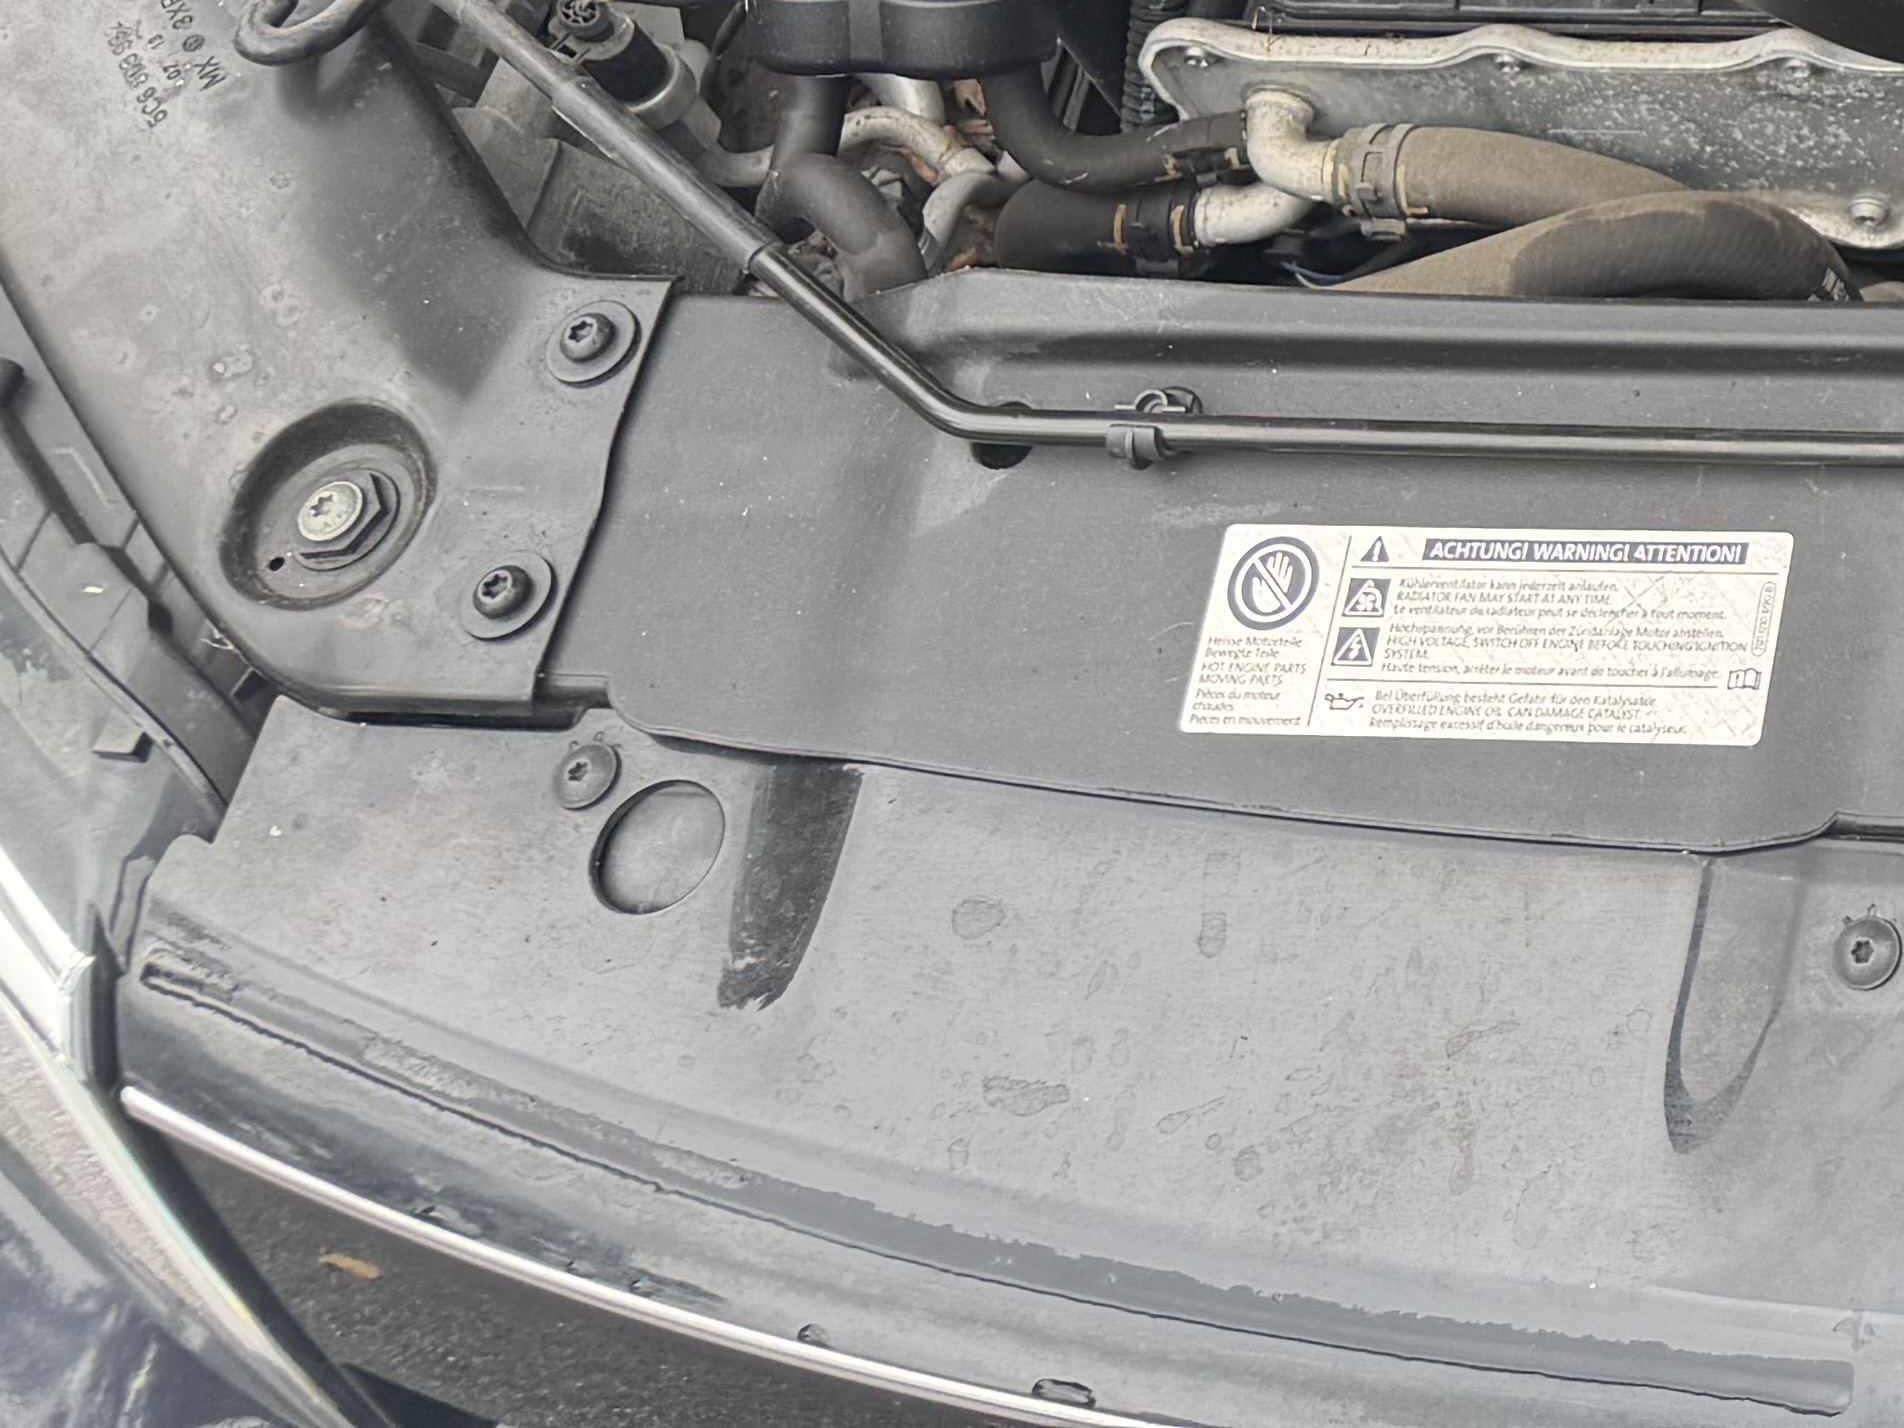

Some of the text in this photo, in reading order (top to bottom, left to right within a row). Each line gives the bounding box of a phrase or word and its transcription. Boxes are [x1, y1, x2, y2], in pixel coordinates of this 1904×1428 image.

[192, 55, 227, 92] MX
[1429, 541, 1742, 563] ACHTUNG! WARNING! ATTENTION!
[1455, 592, 1476, 602] FAN
[1506, 592, 1539, 604] START
[1557, 593, 1582, 604] ANY
[1386, 635, 1417, 646] HIGH
[1201, 661, 1226, 673] HOT
